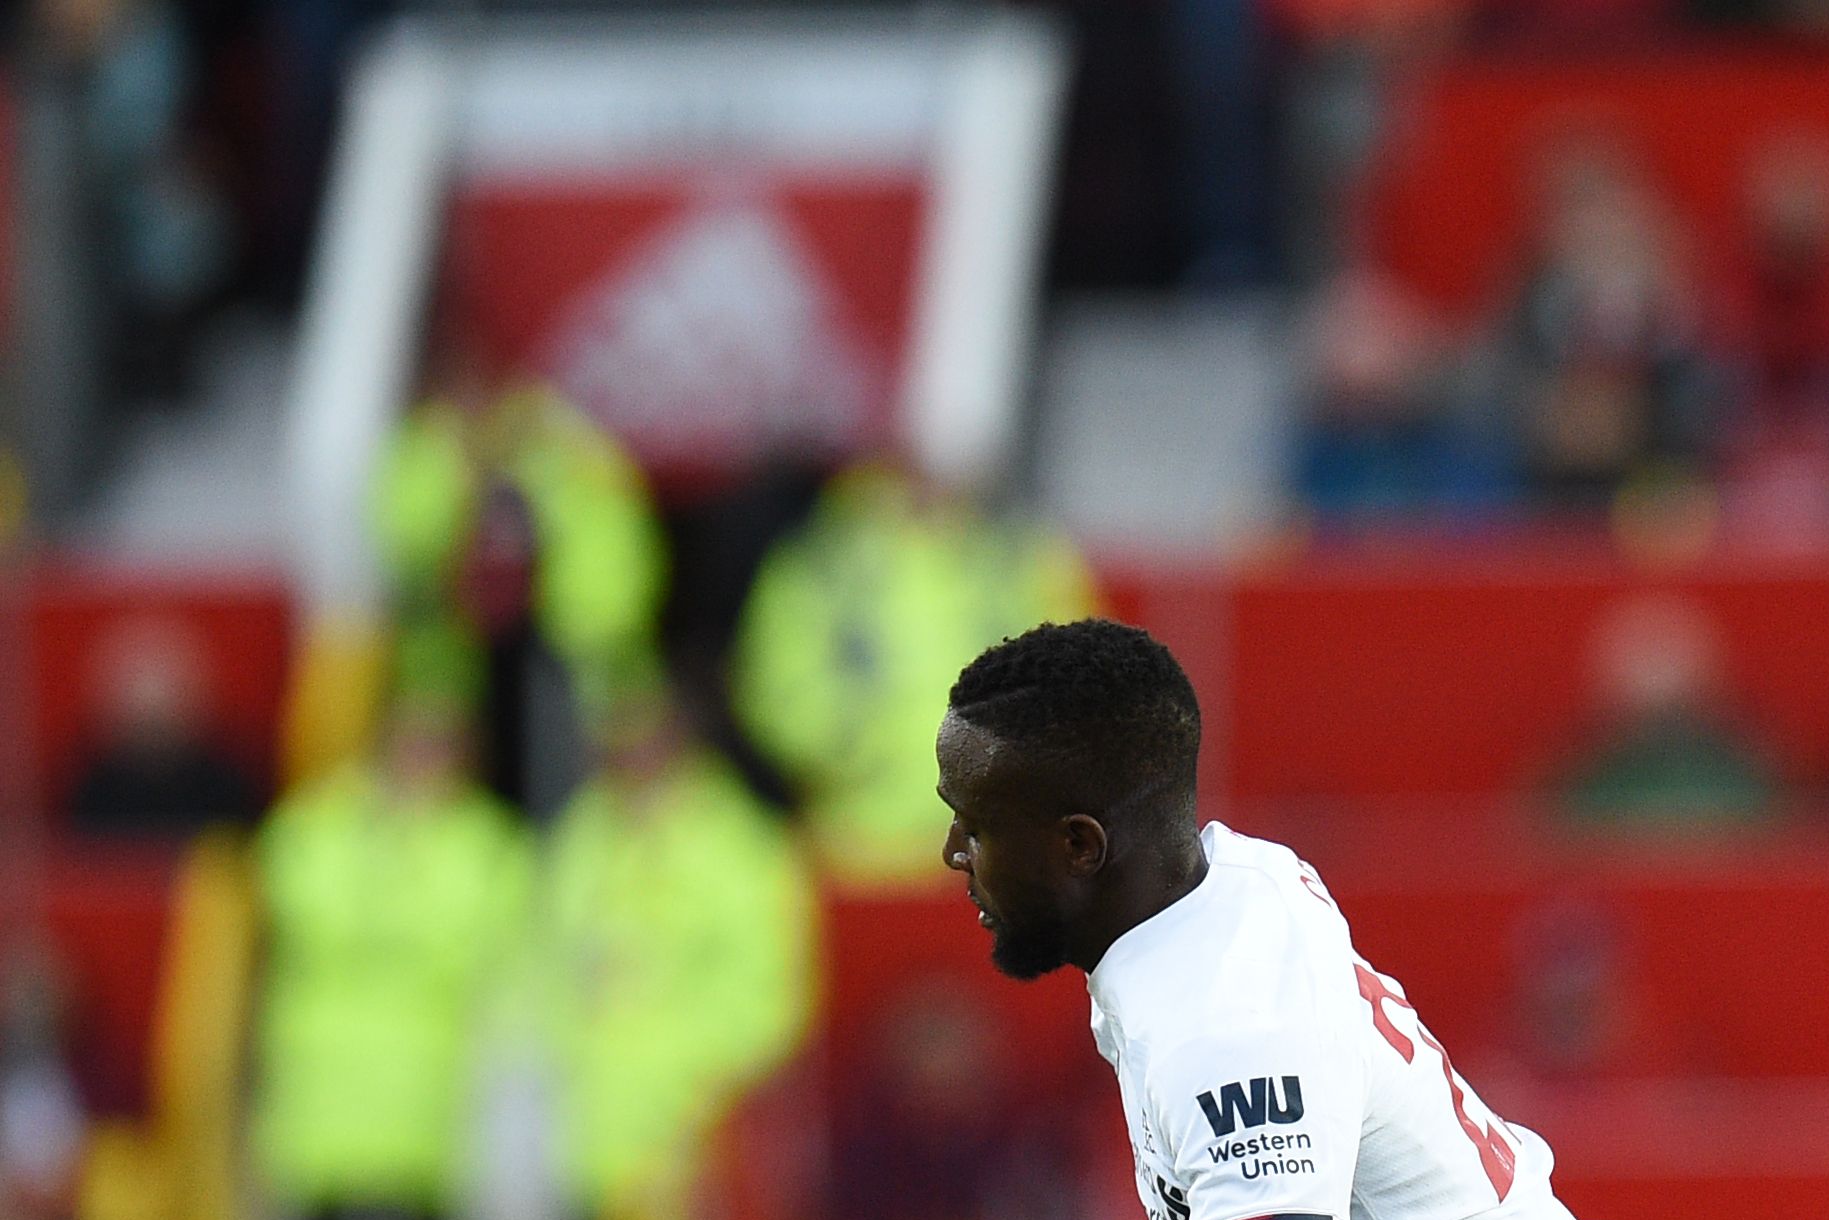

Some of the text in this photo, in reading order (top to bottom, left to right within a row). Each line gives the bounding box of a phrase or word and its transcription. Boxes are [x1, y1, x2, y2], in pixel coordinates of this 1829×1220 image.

[1196, 1076, 1304, 1137] WU
[1208, 1133, 1311, 1164] Western
[1242, 1154, 1315, 1180] Union
